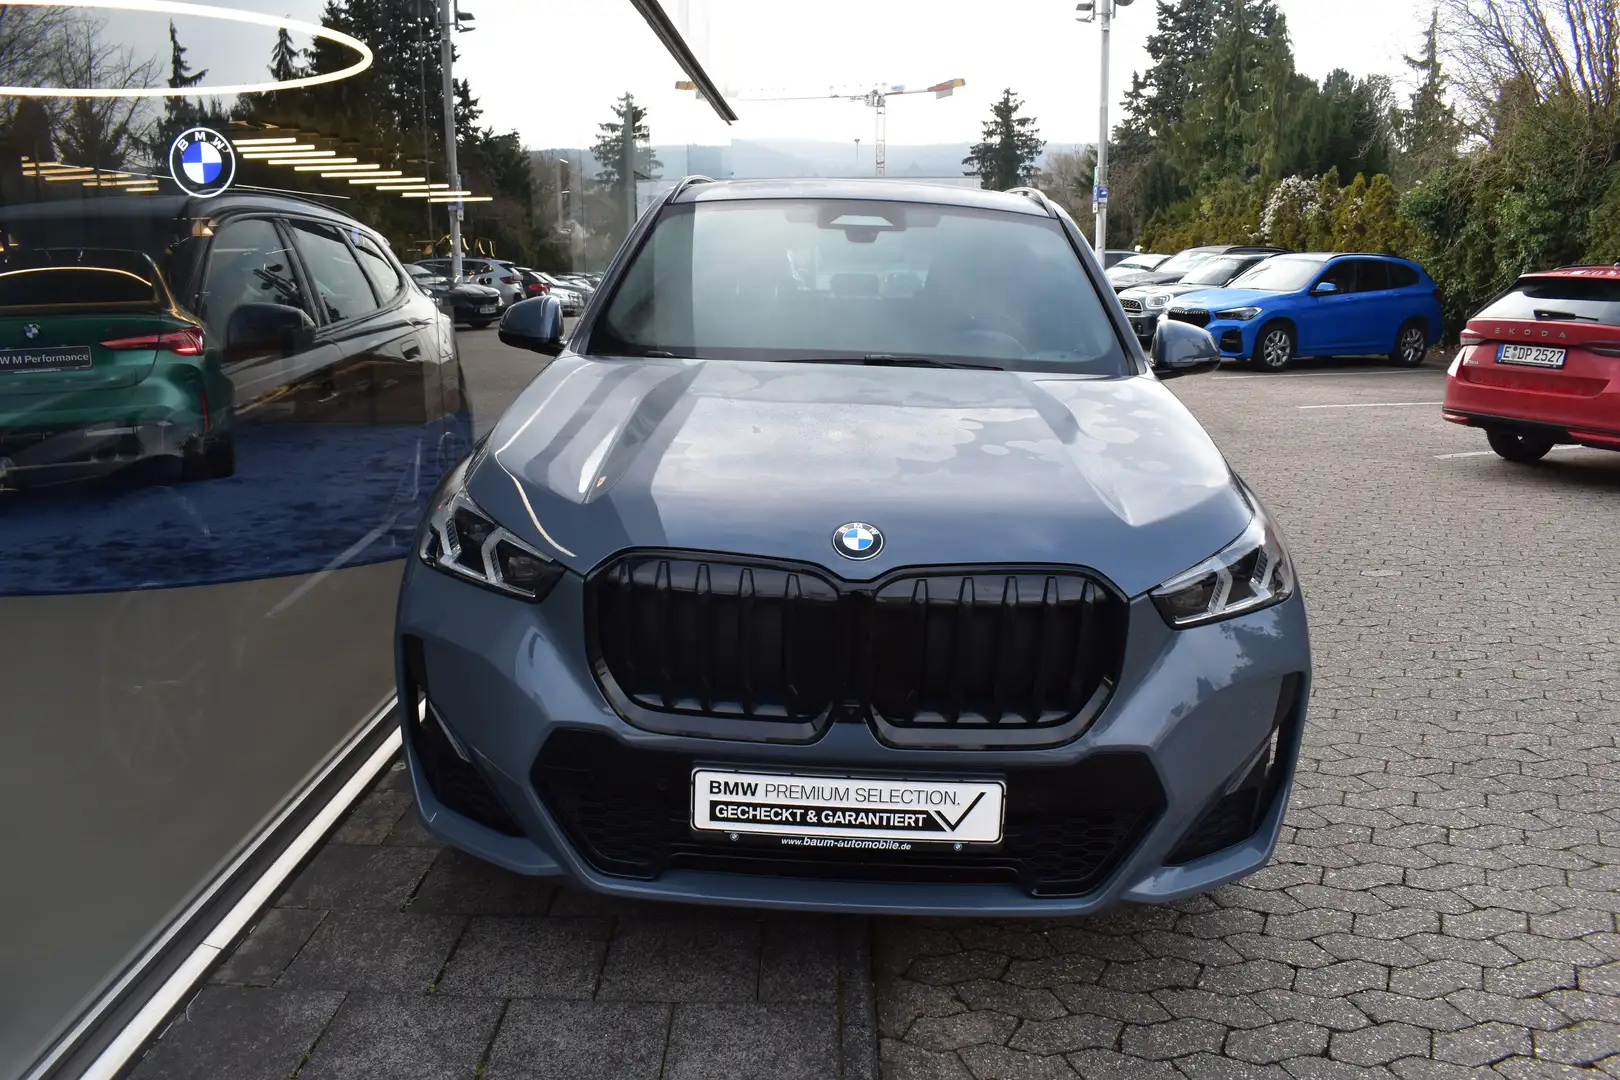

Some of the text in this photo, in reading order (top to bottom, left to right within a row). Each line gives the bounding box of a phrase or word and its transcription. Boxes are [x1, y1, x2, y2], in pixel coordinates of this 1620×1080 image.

[177, 131, 225, 151] BMW
[12, 355, 22, 364] M
[24, 353, 89, 364] Performance
[1503, 346, 1564, 363] E DP 2527
[838, 523, 880, 535] BMW
[709, 780, 960, 806] BMW PREMIUM SELECTION.
[715, 804, 927, 827] GECHECKT & GARANTIERT
[781, 837, 912, 850] www.baum-automobile.de
